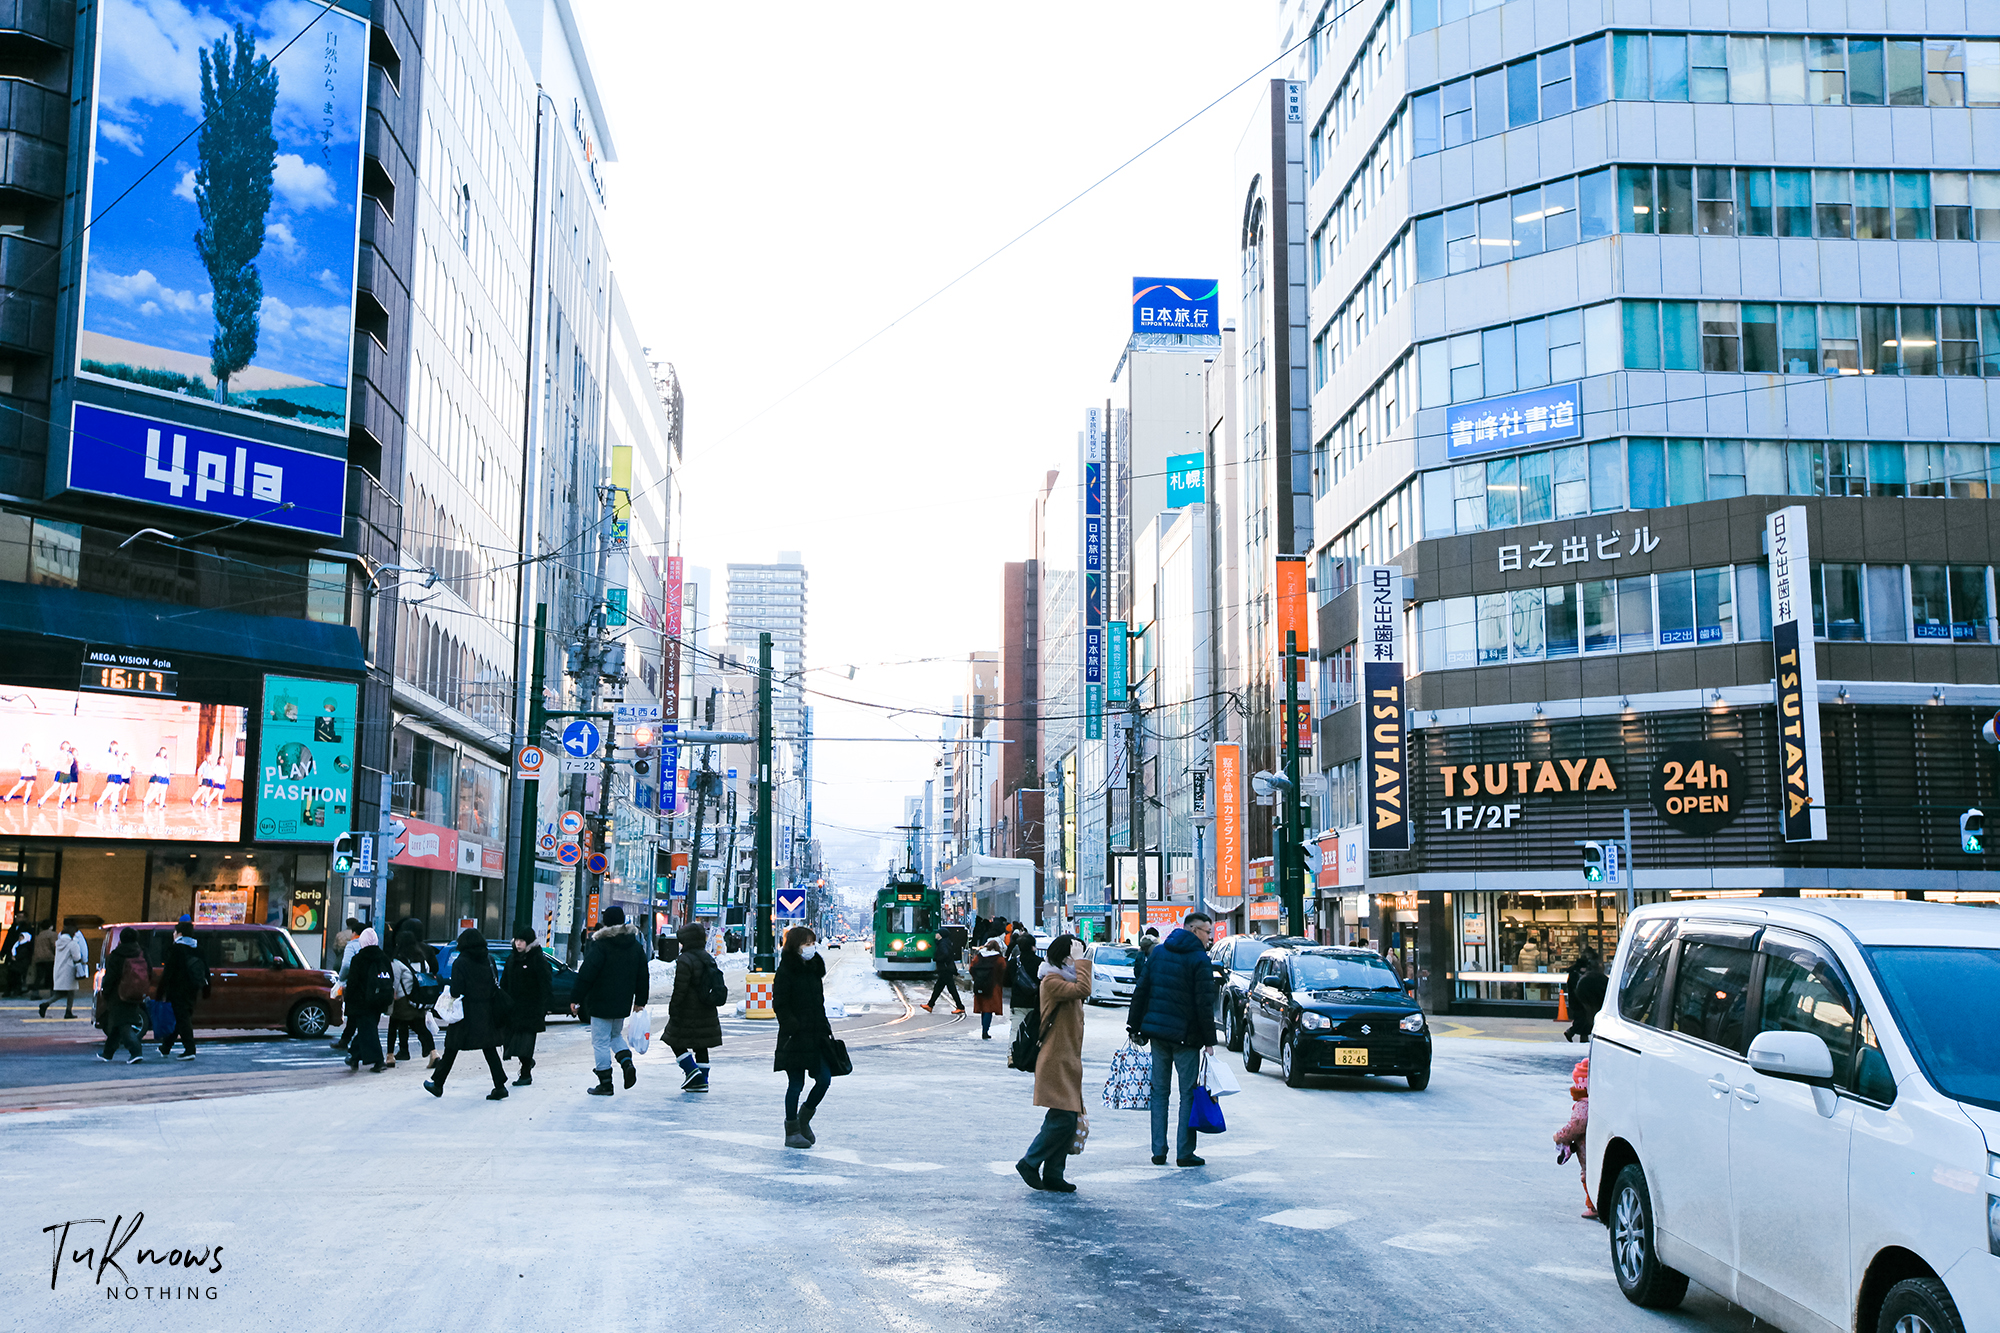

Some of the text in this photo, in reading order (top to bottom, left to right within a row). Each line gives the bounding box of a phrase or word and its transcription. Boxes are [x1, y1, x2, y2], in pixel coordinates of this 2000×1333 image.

[1141, 307, 1209, 323] 日本旅行
[1450, 400, 1574, 447] 書峰社書道
[144, 428, 283, 504] 4pla
[1170, 470, 1205, 490] 札幌
[1088, 523, 1099, 565] 日本旅行
[1498, 526, 1661, 573] 日之出ビル
[1774, 514, 1791, 622] 日之出歯科
[1373, 570, 1394, 661] 日之出歯科
[1662, 628, 1720, 643] 日之出 歯科
[1918, 626, 1973, 637] 日之出 歯科
[90, 652, 171, 668] MEGA VISION 4pla
[1088, 634, 1099, 677] 日本旅行
[1113, 627, 1121, 697] 札幌美容形成外科
[101, 667, 163, 692] 16:17
[1780, 648, 1806, 818] TSUTAYA
[265, 760, 317, 781] PLAY!
[524, 753, 539, 764] 40
[1373, 686, 1401, 831] TSUTAYA
[1440, 758, 1617, 797] TSUTAYA
[1663, 760, 1729, 791] 24h
[264, 784, 347, 803] FASHION
[1666, 795, 1729, 815] OPEN
[1441, 804, 1521, 830] 1F/2F
[1223, 805, 1234, 893] カラダファクトリー
[295, 890, 322, 900] Seria
[1342, 1055, 1367, 1064] 82-45
